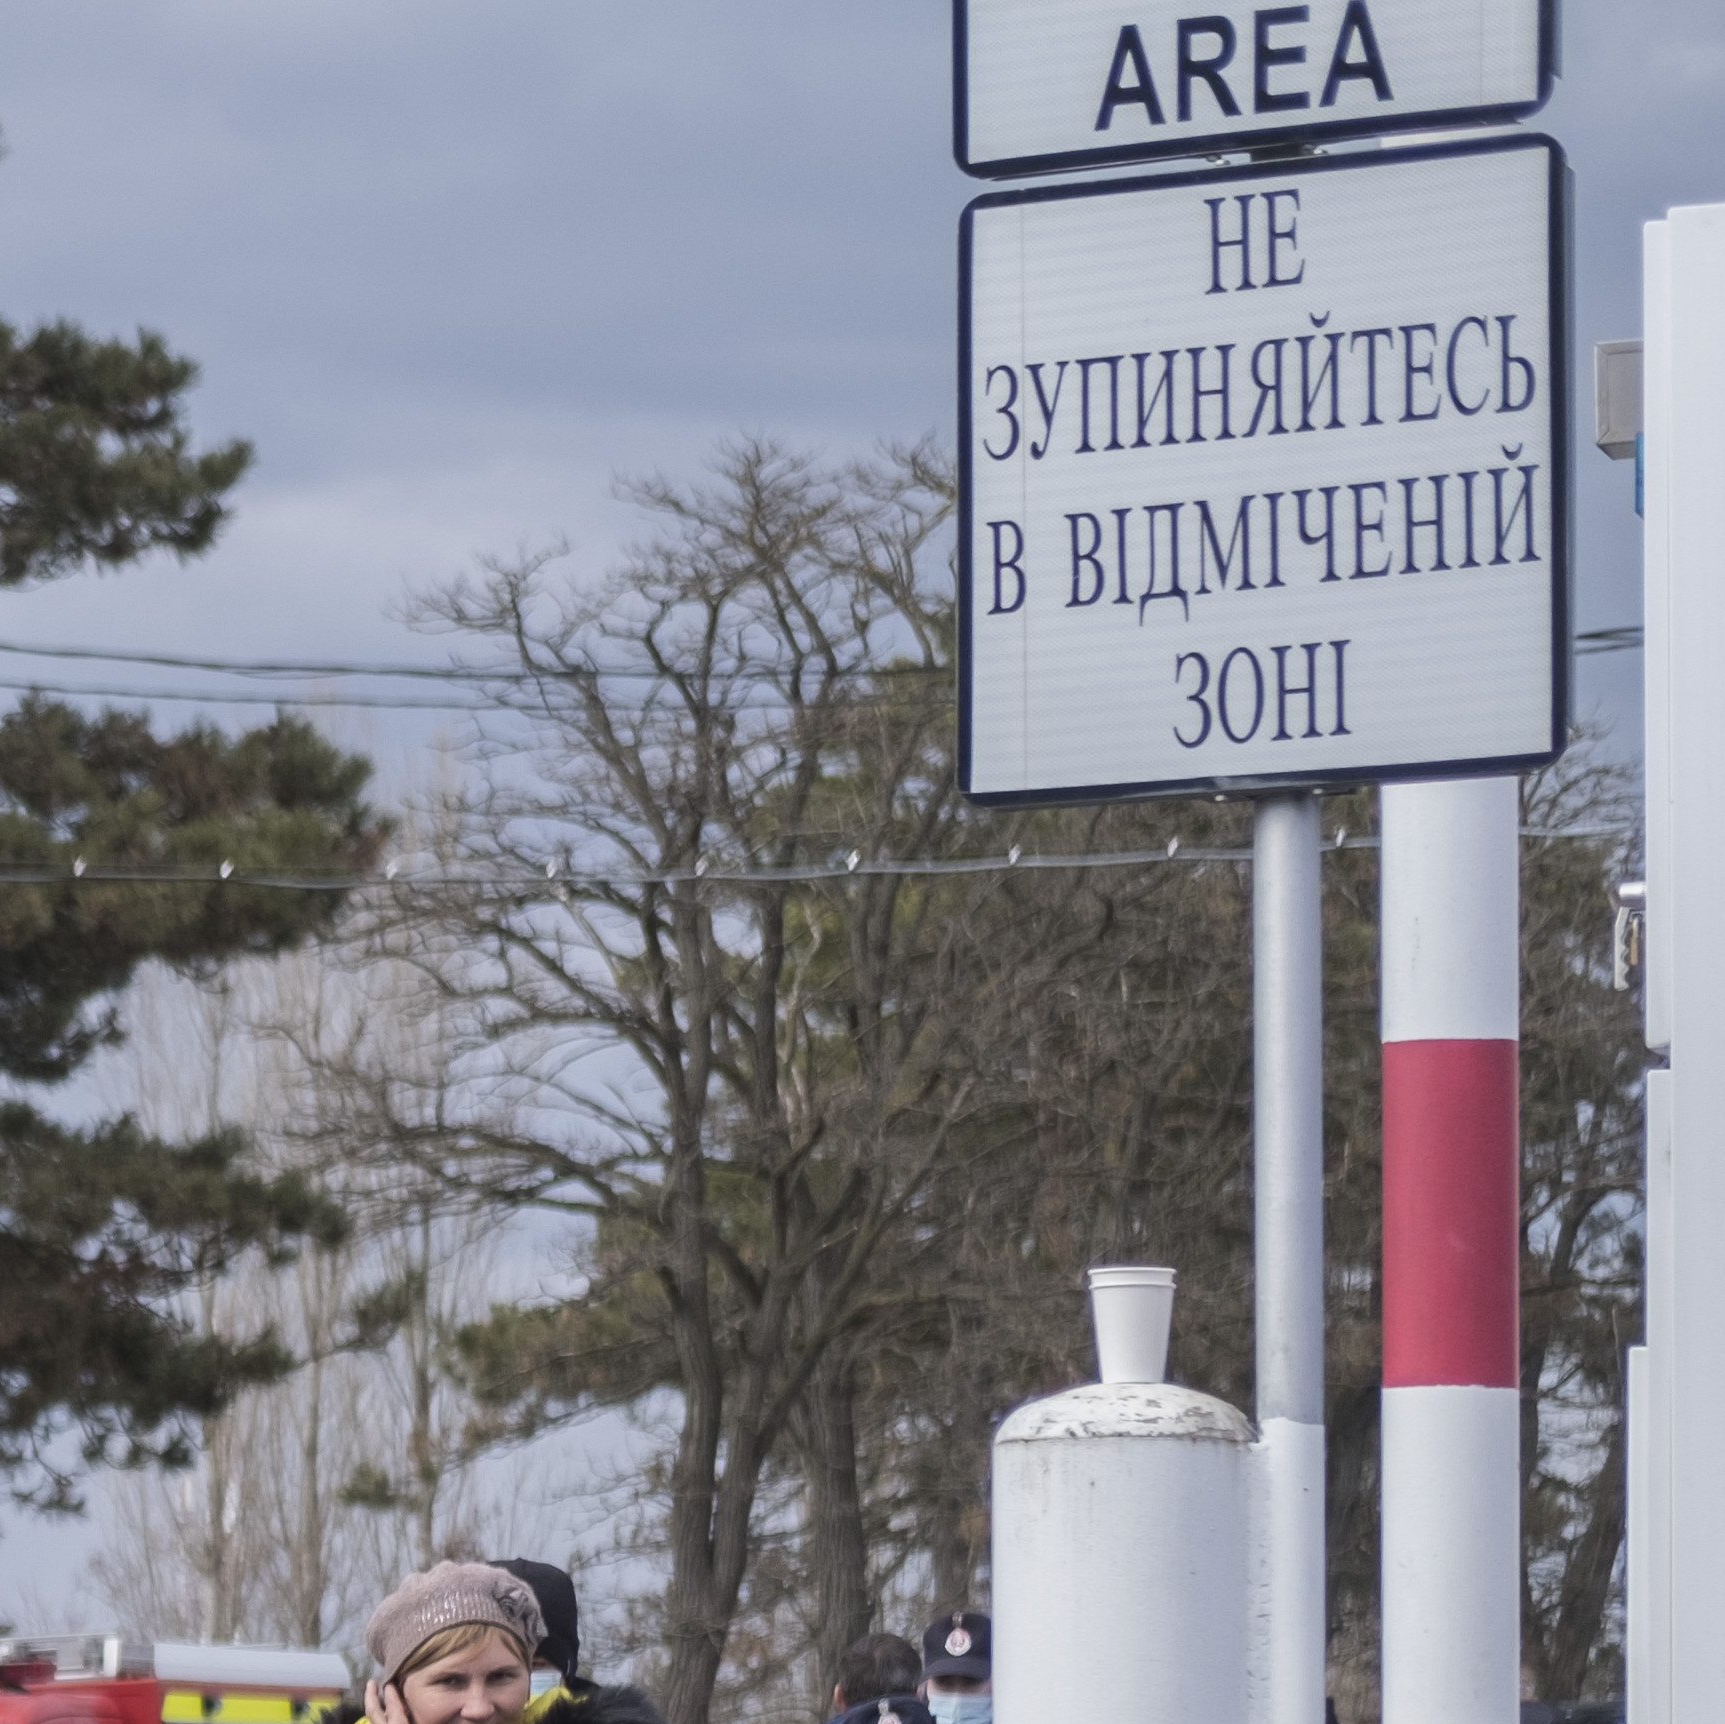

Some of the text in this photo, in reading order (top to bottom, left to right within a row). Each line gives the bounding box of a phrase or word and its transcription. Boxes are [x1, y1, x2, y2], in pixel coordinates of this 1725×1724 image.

[1093, 0, 1395, 132] AREA
[1203, 188, 1306, 296] НЕ
[982, 310, 1537, 462] ЗУПИНЯЙТЕСЬ
[985, 443, 1542, 627] В ВІДМІЧЕНІЙ
[1172, 639, 1352, 749] ЗОНІ
